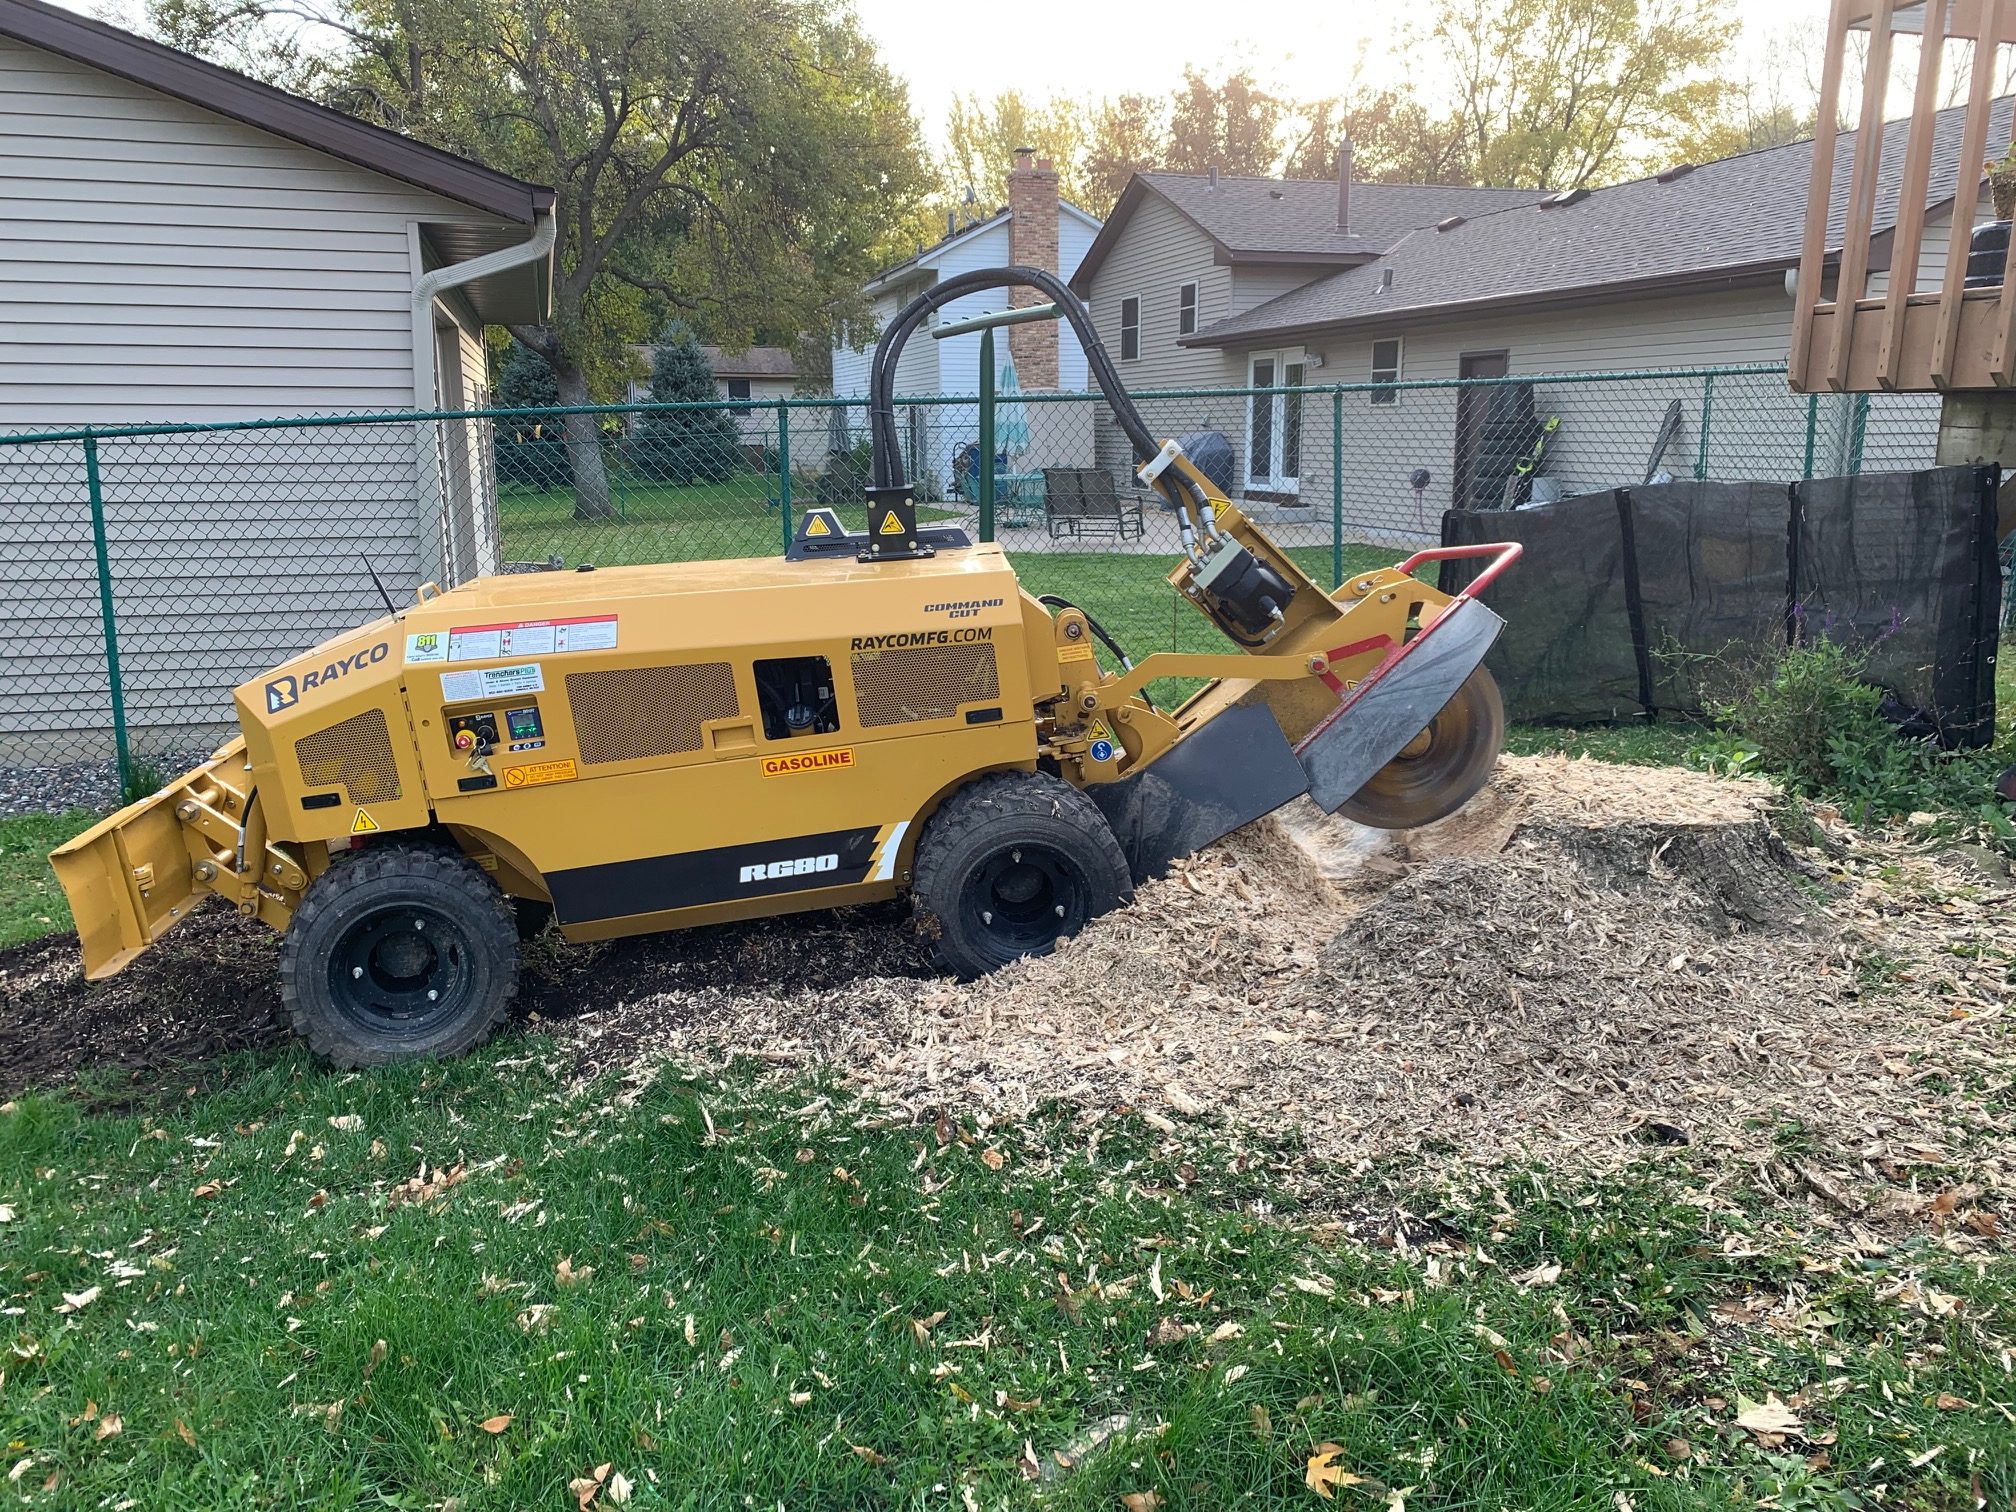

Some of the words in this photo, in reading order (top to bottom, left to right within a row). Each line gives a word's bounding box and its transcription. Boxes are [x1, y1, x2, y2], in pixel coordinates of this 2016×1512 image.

[923, 598, 1004, 613] COMMAND
[949, 608, 981, 619] CUT
[524, 620, 551, 628] DANGER
[416, 634, 438, 647] 811
[851, 626, 993, 651] RAYCOMFG.COM
[302, 642, 389, 693] RAYCO
[529, 761, 571, 773] ATTENTION!
[765, 751, 851, 773] GASOLINE
[739, 853, 839, 883] RG80
